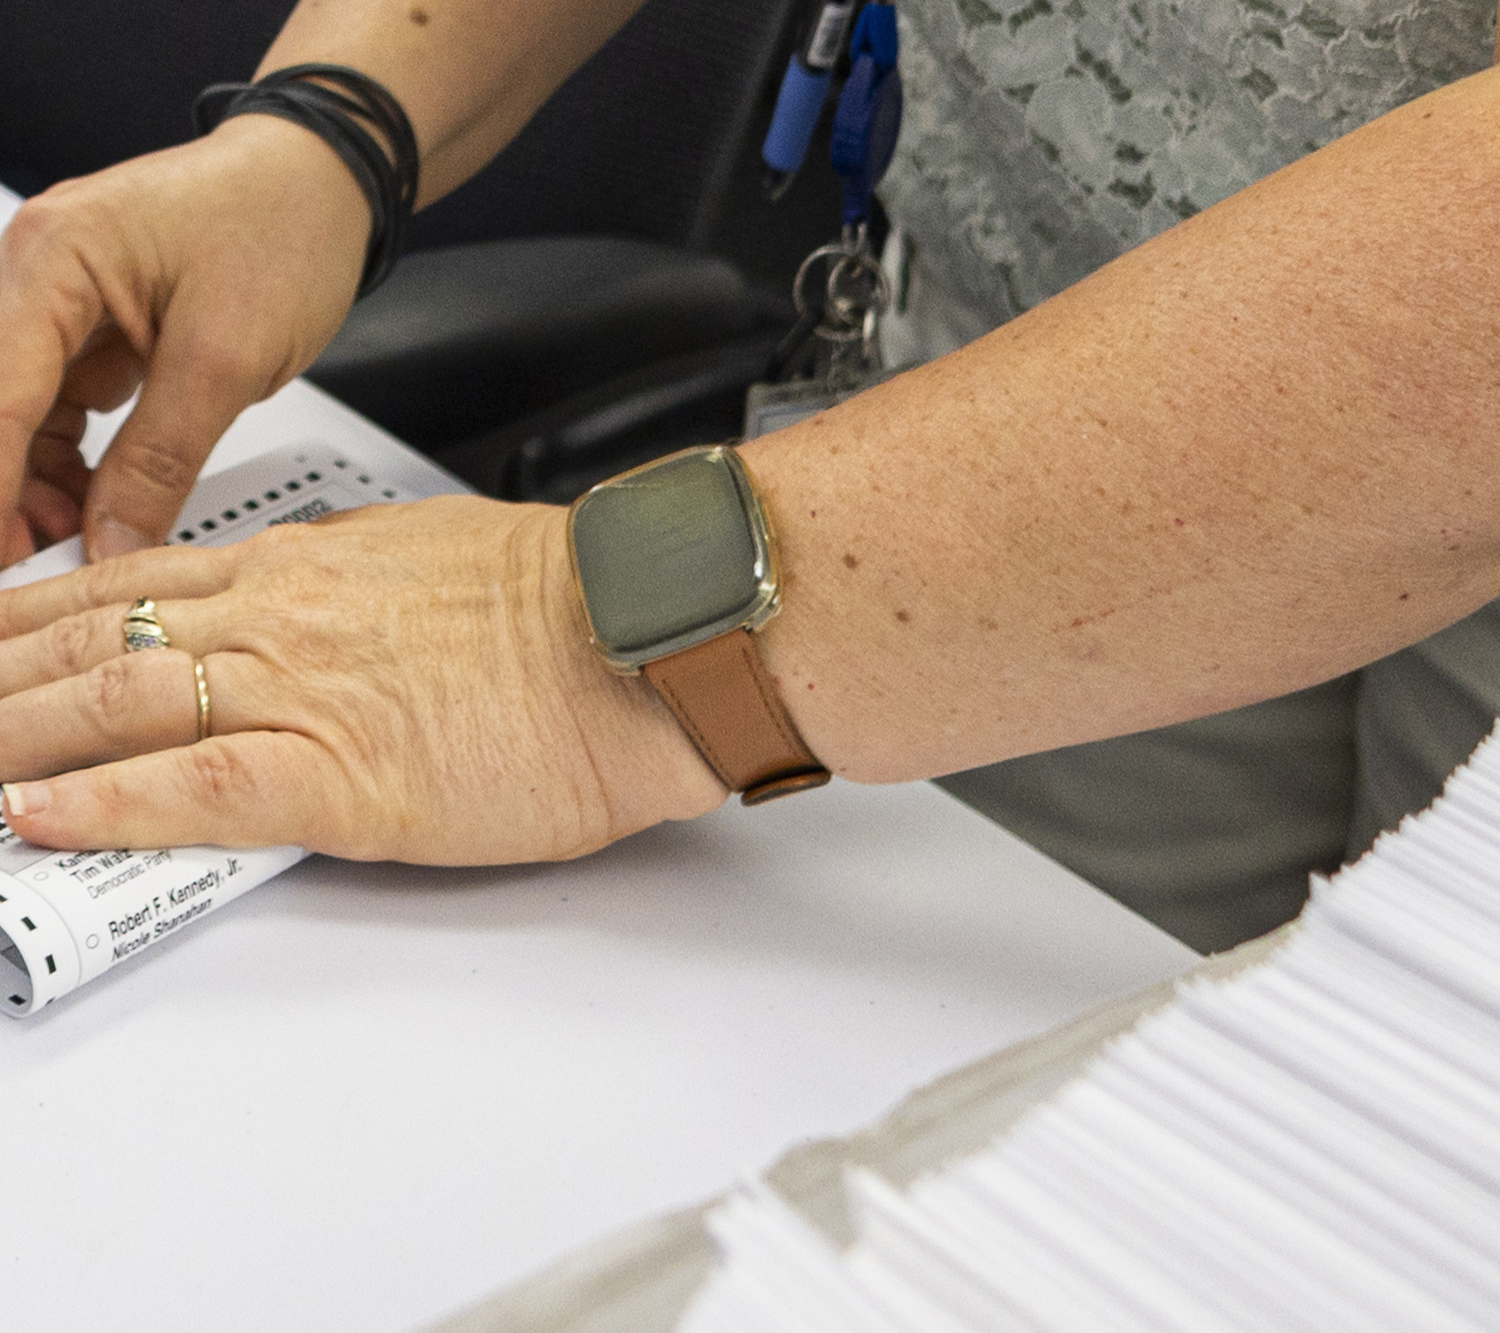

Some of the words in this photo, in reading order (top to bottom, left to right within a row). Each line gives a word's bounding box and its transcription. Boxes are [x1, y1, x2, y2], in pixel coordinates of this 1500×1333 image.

[69, 866, 102, 884] Tim
[87, 863, 145, 899] Democratic
[108, 904, 152, 941] Robert
[152, 896, 168, 913] F.
[166, 868, 225, 909] Kennedy,
[226, 857, 244, 877] Jr.
[111, 932, 150, 963] Nicole
[154, 899, 212, 939] Shanahan
